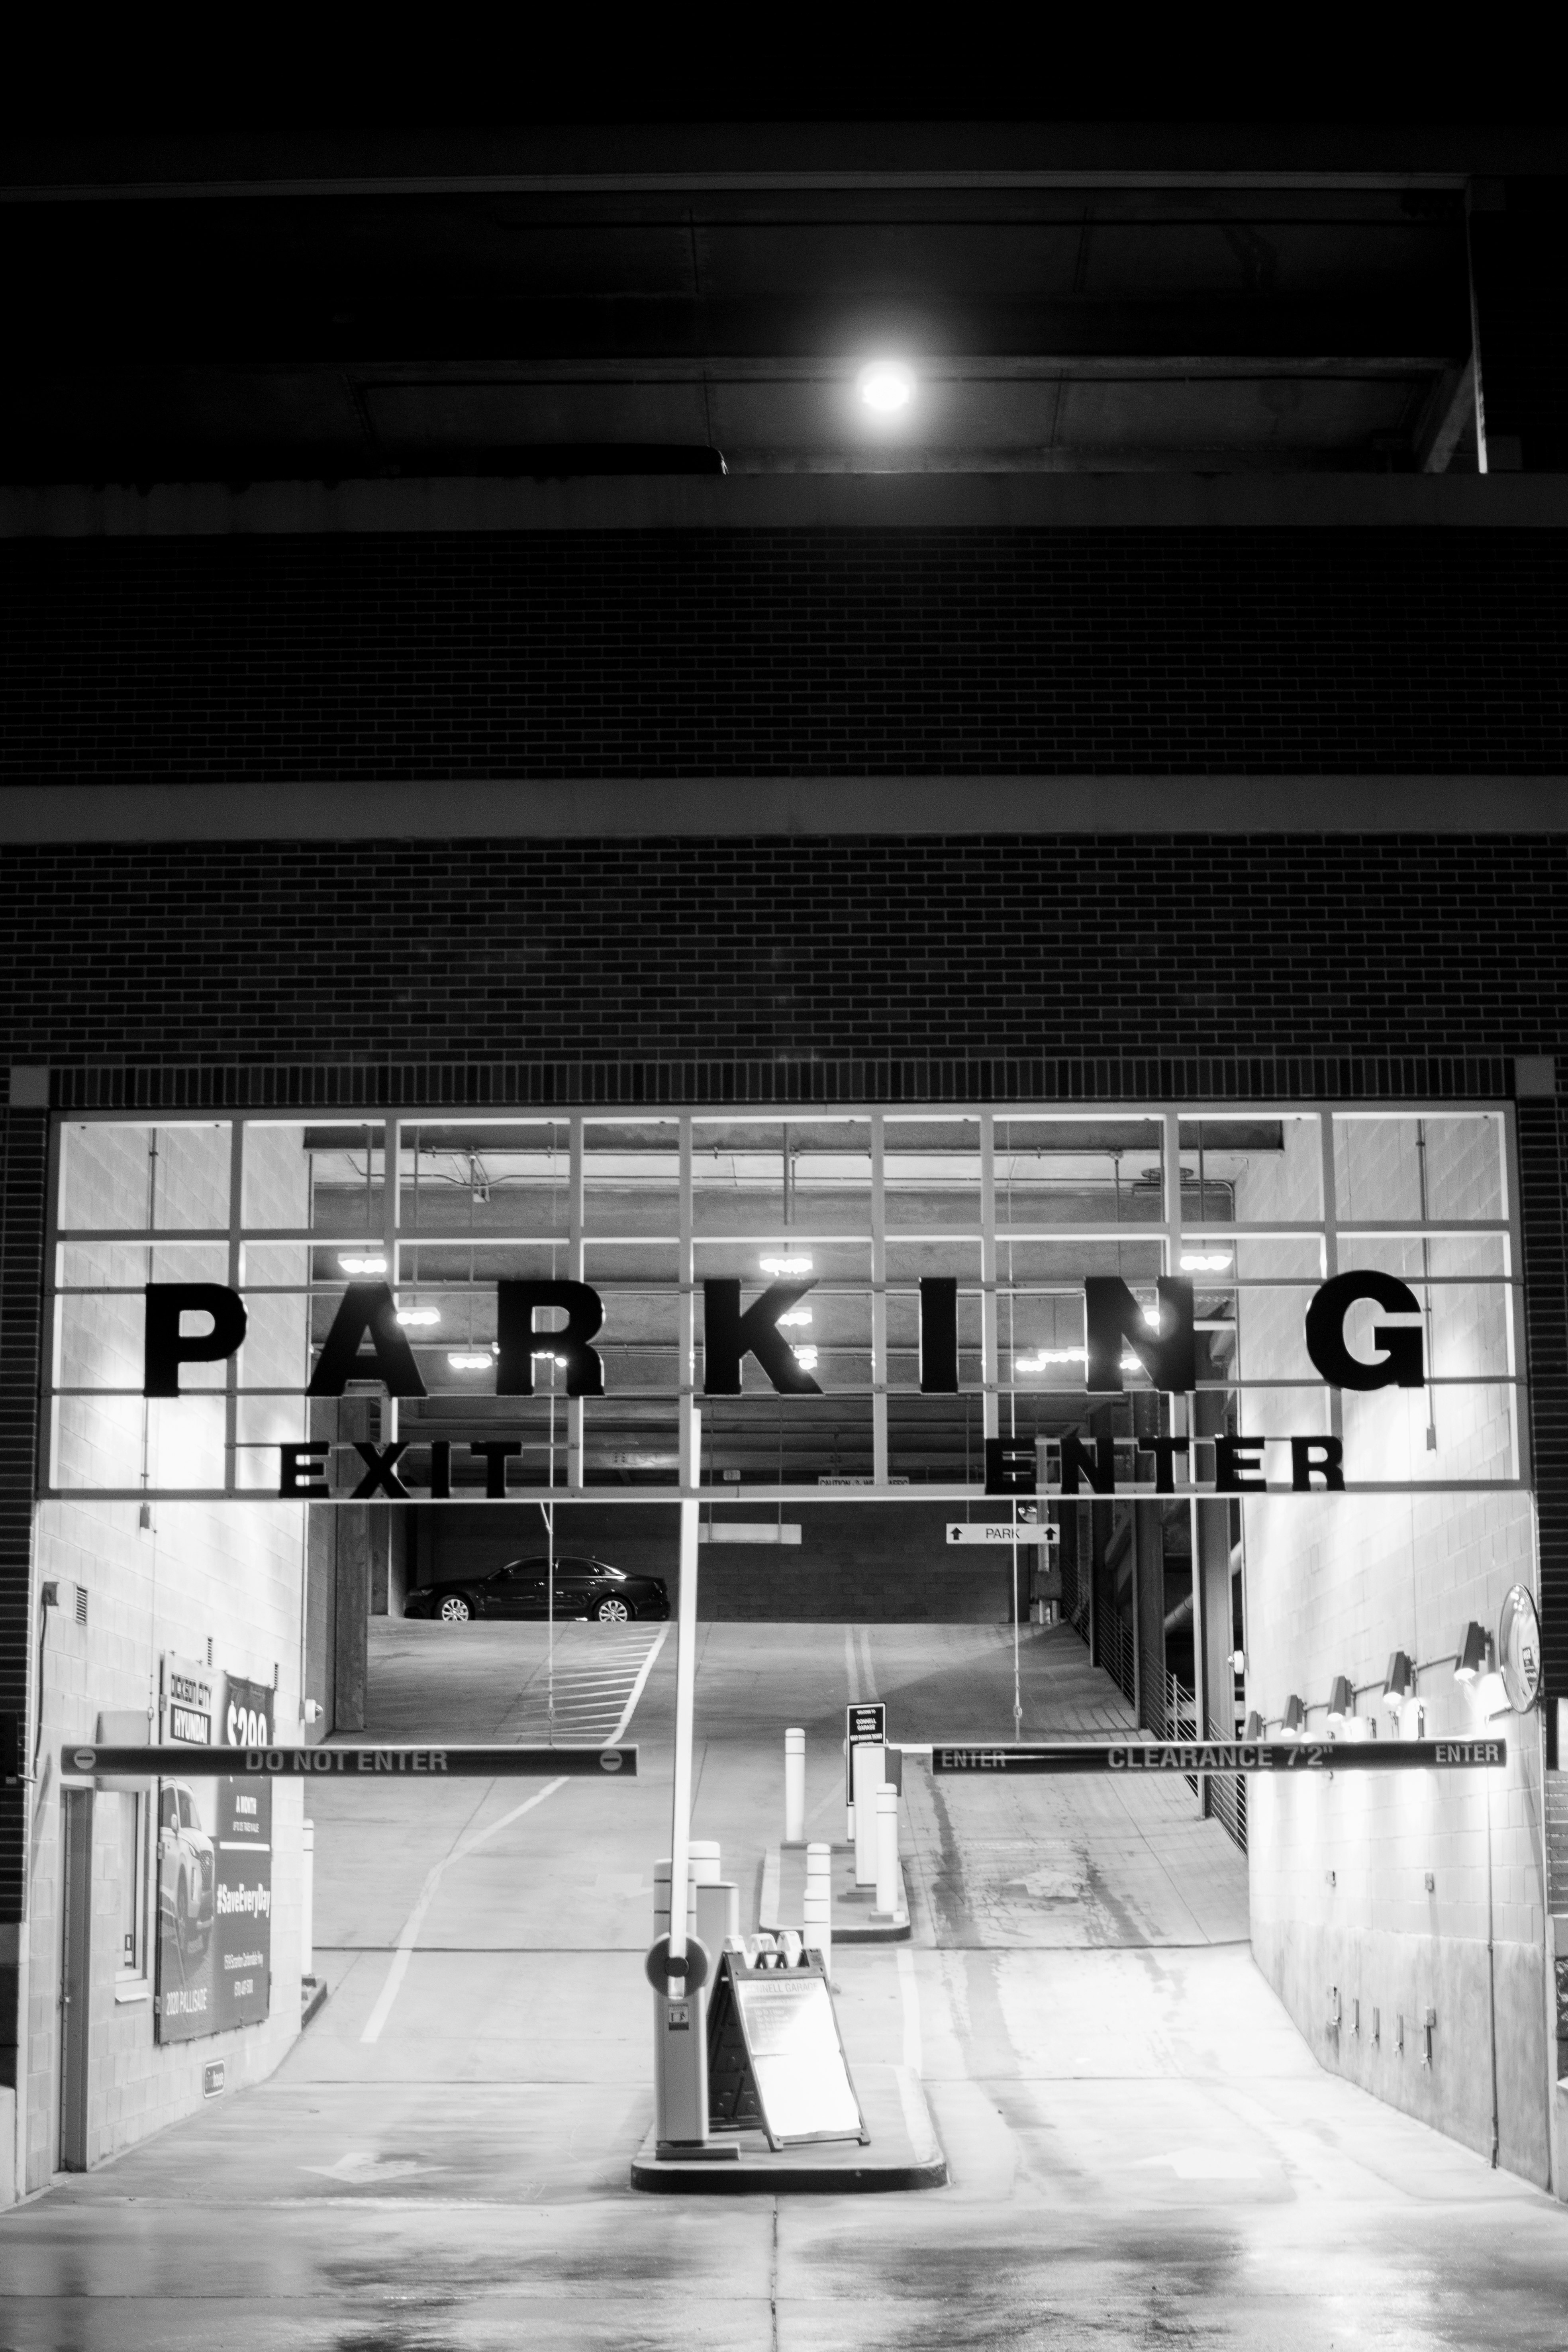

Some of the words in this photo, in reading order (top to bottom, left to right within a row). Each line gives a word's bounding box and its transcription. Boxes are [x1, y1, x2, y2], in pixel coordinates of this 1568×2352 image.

[144, 1270, 1425, 1398] PARKING
[279, 1441, 522, 1499] EXIT
[985, 1435, 1346, 1495] ENTER
[986, 1528, 1020, 1539] PARK
[174, 1708, 208, 1744] HYUNDAI
[246, 1750, 284, 1771] DO
[293, 1750, 350, 1771] NOT
[358, 1751, 448, 1772] ENTER
[941, 1750, 1006, 1768] ENTER
[1109, 1746, 1273, 1768] CLEARANCE
[1284, 1745, 1335, 1766] 7'2"
[1435, 1743, 1499, 1763] ENTER
[217, 1883, 270, 1919] #SaveEveryDay
[785, 1982, 819, 1992] GARAGE
[167, 1991, 179, 2016] 2020
